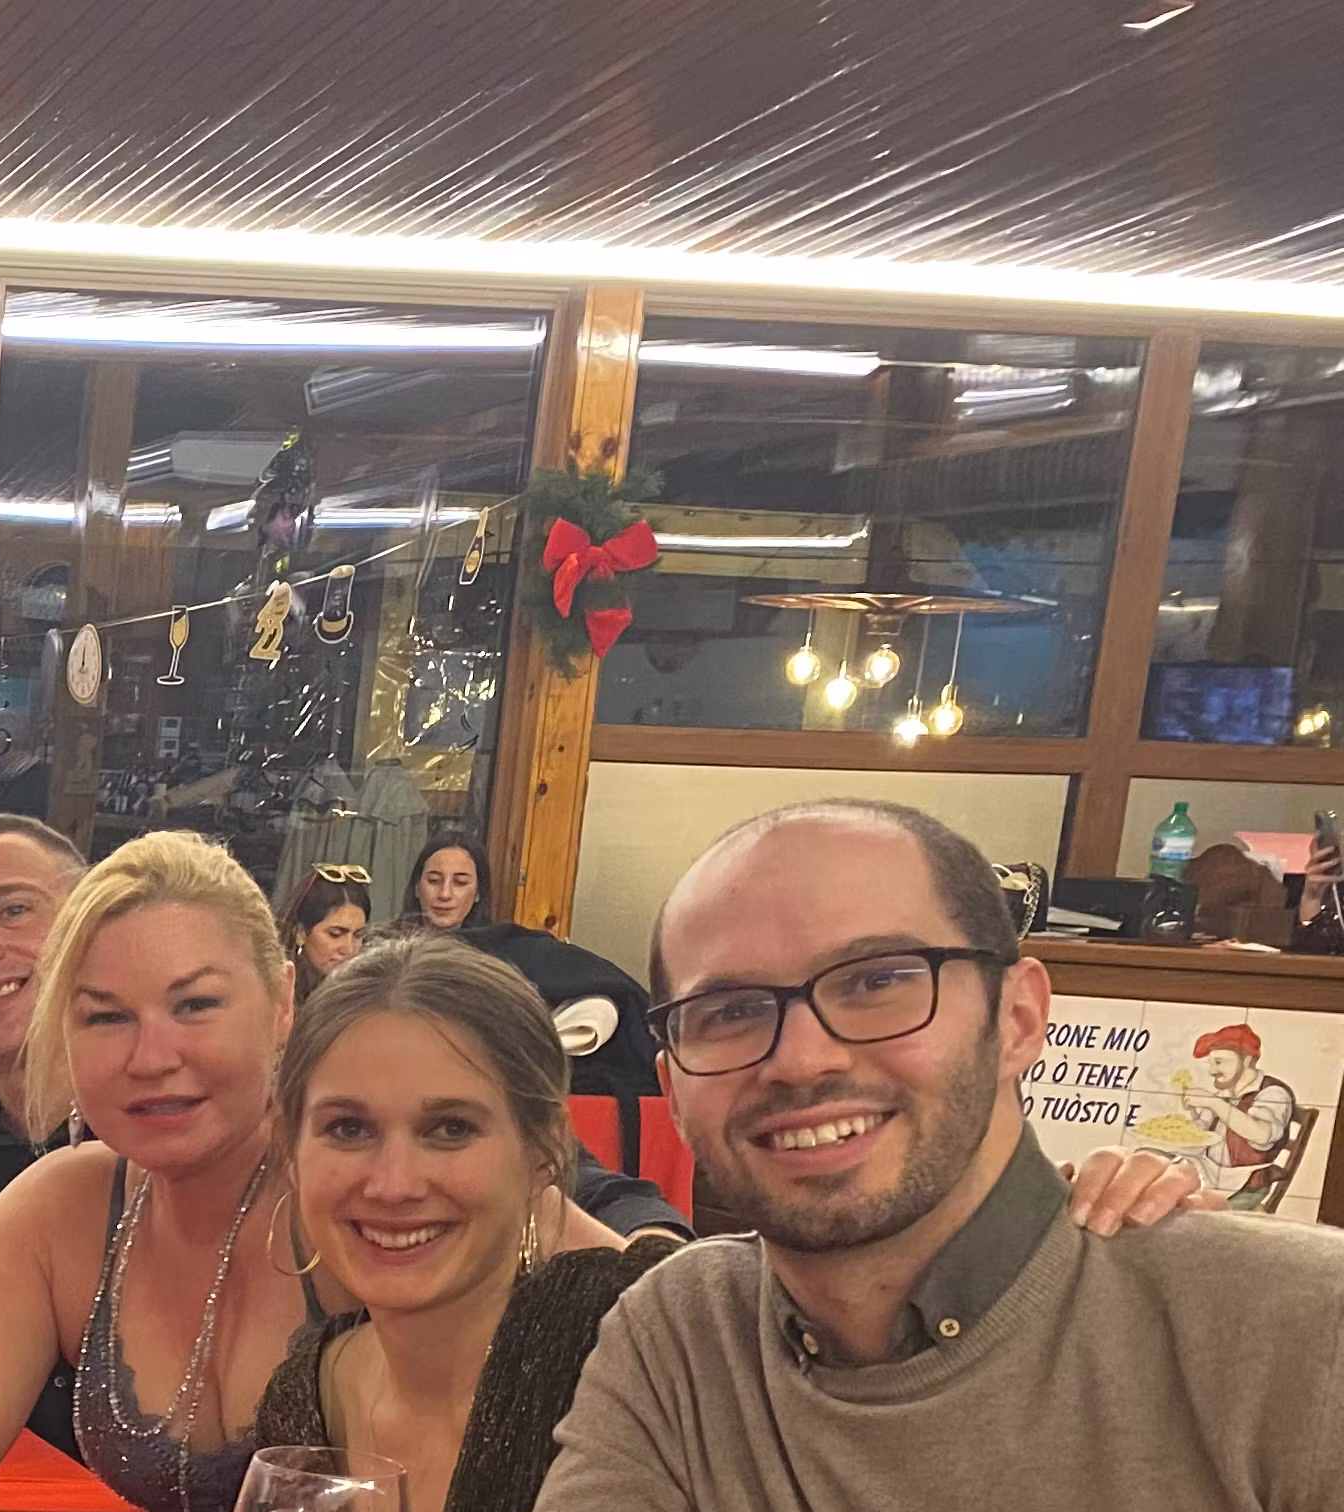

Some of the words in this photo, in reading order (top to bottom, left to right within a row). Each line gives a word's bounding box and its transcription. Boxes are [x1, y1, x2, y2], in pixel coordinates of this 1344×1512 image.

[1102, 1026, 1151, 1053] MIO
[1022, 1059, 1046, 1083] O
[1074, 1062, 1139, 1090] TENE!
[1041, 1092, 1120, 1126] TUÒSTO
[1125, 1103, 1141, 1128] E
